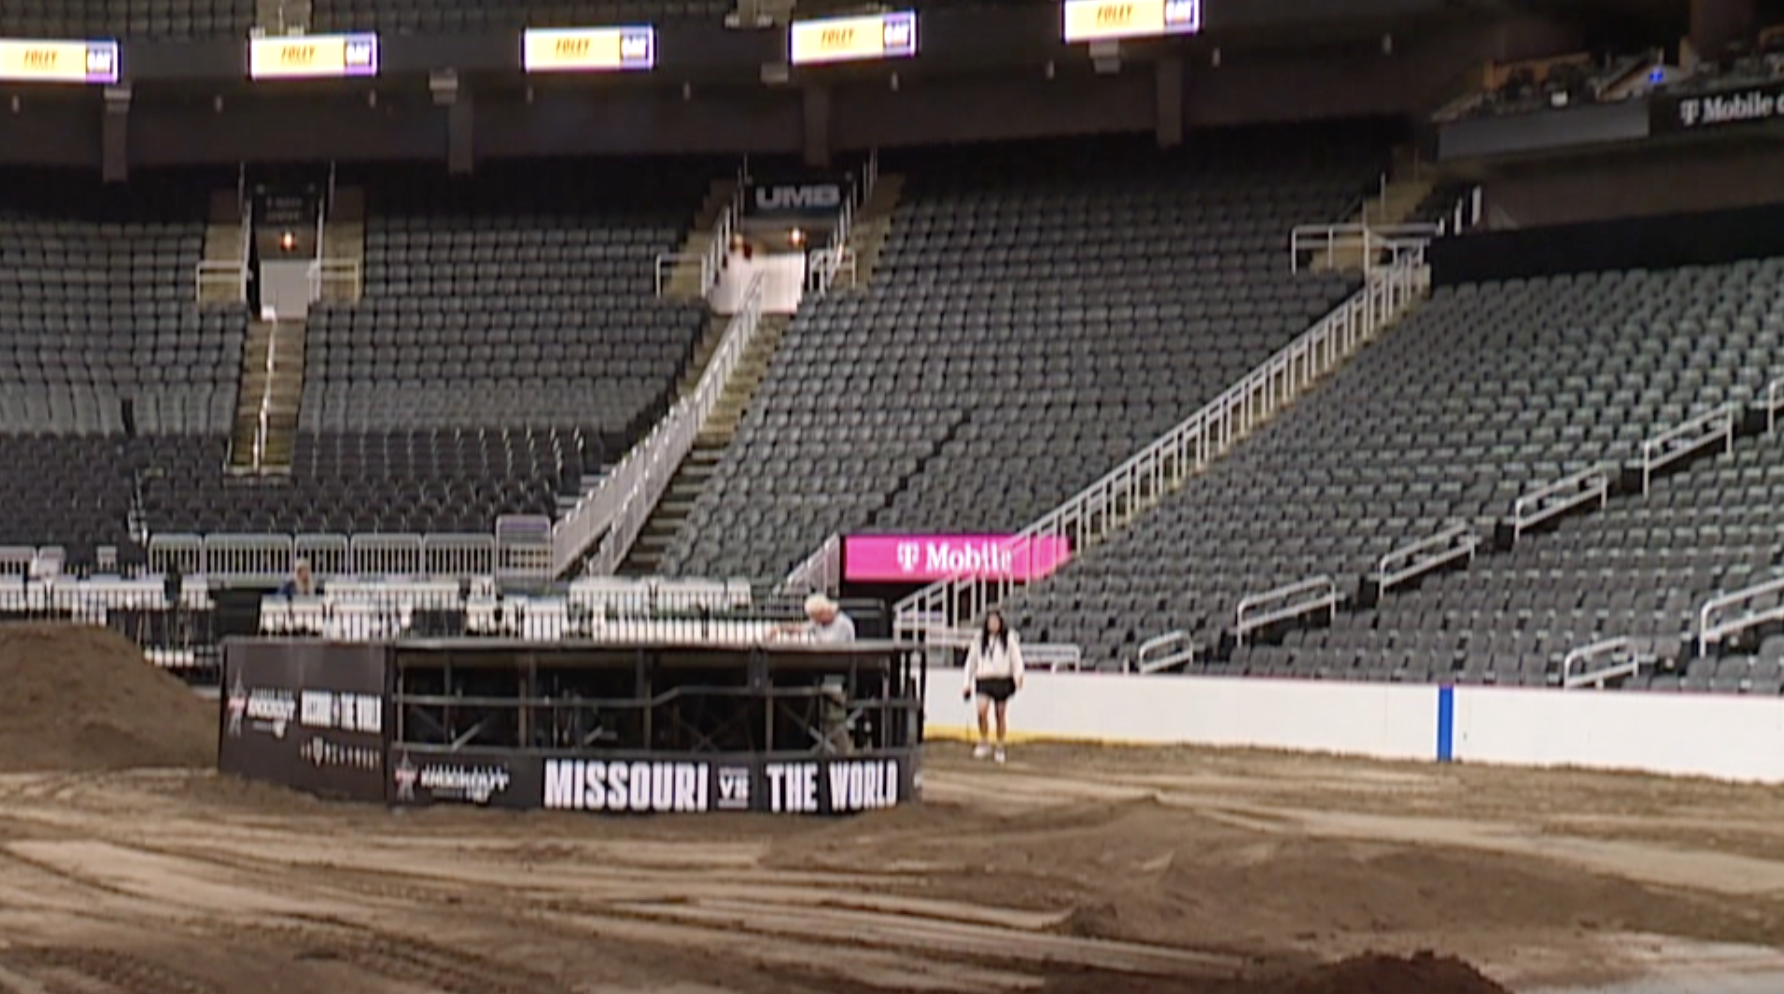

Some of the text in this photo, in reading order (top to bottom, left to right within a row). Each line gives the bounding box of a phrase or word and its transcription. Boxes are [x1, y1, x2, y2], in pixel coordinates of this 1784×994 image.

[1702, 91, 1773, 123] Mobile
[755, 184, 840, 208] UMB
[926, 541, 1012, 573] Mobile
[543, 759, 899, 812] MISSOURI VS THE WORLD
